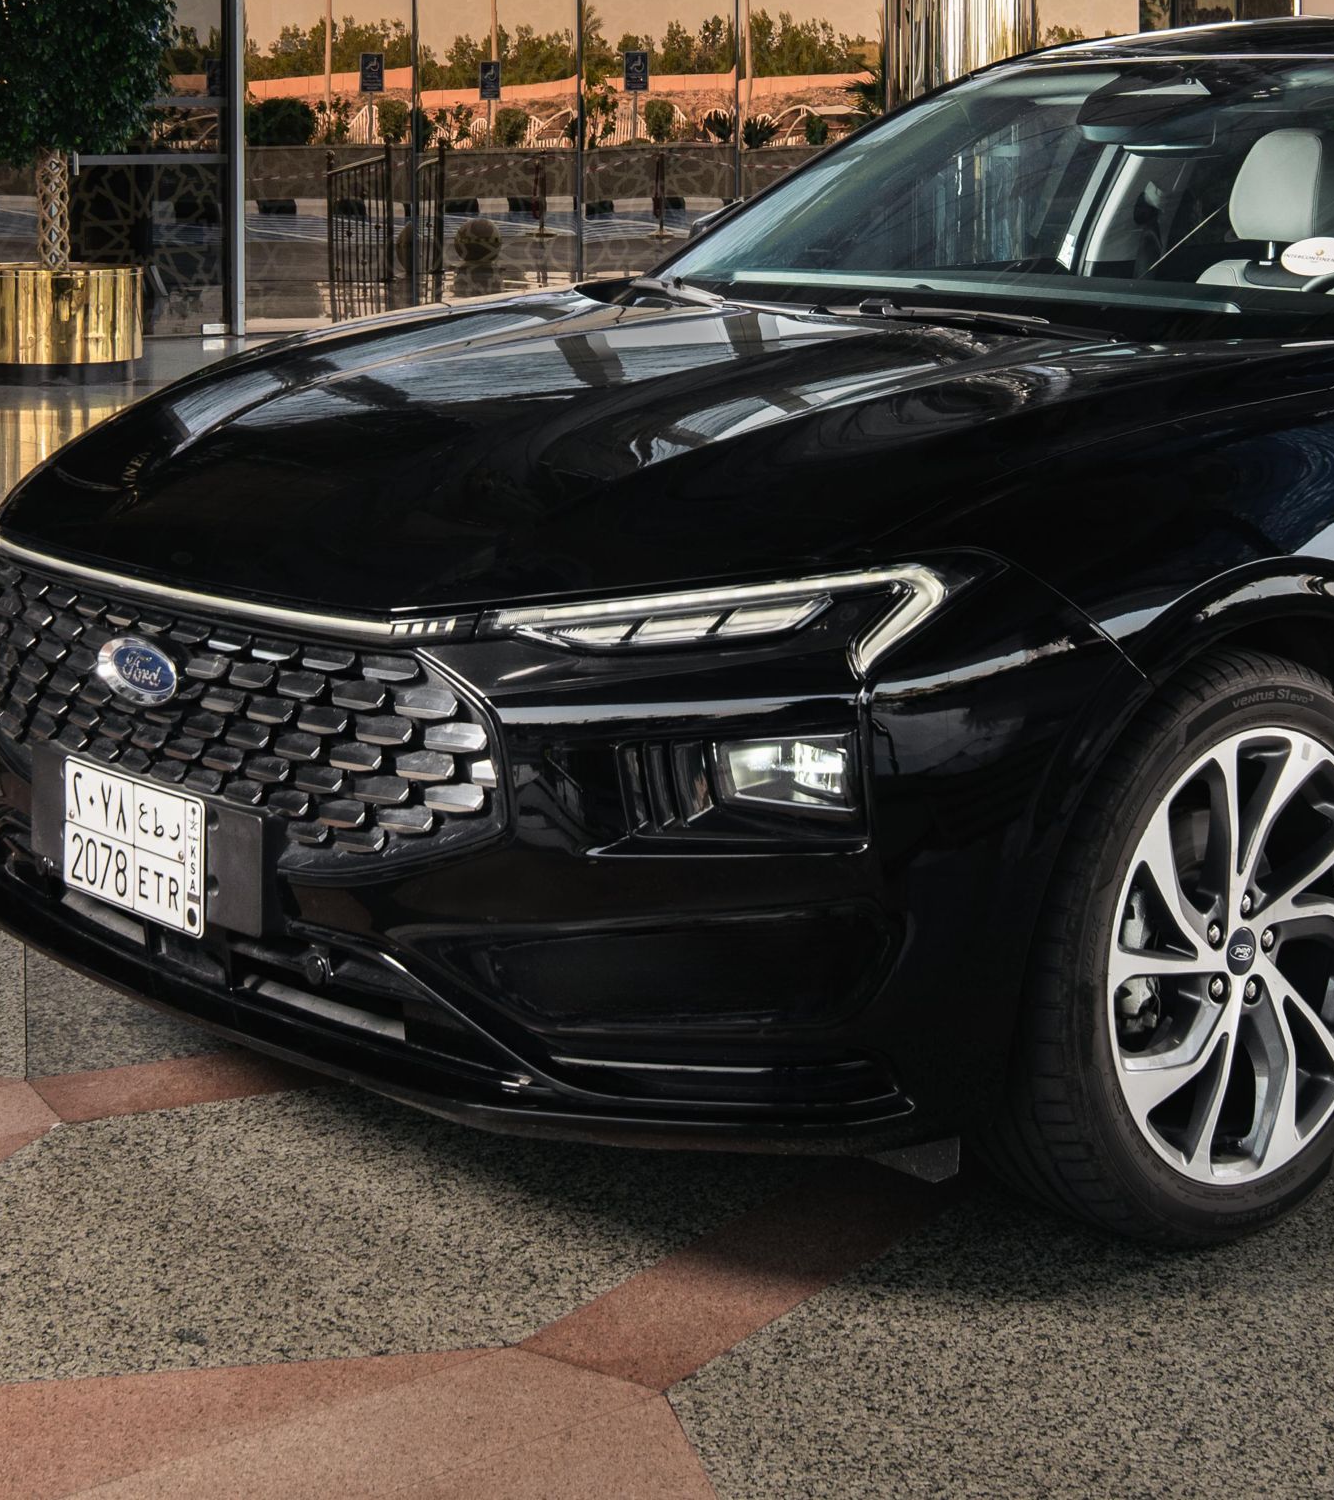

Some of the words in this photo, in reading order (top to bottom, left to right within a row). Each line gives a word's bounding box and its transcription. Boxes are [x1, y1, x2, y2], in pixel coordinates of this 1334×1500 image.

[123, 651, 162, 687] Ford
[71, 832, 128, 898] 2078
[138, 865, 179, 912] ETR
